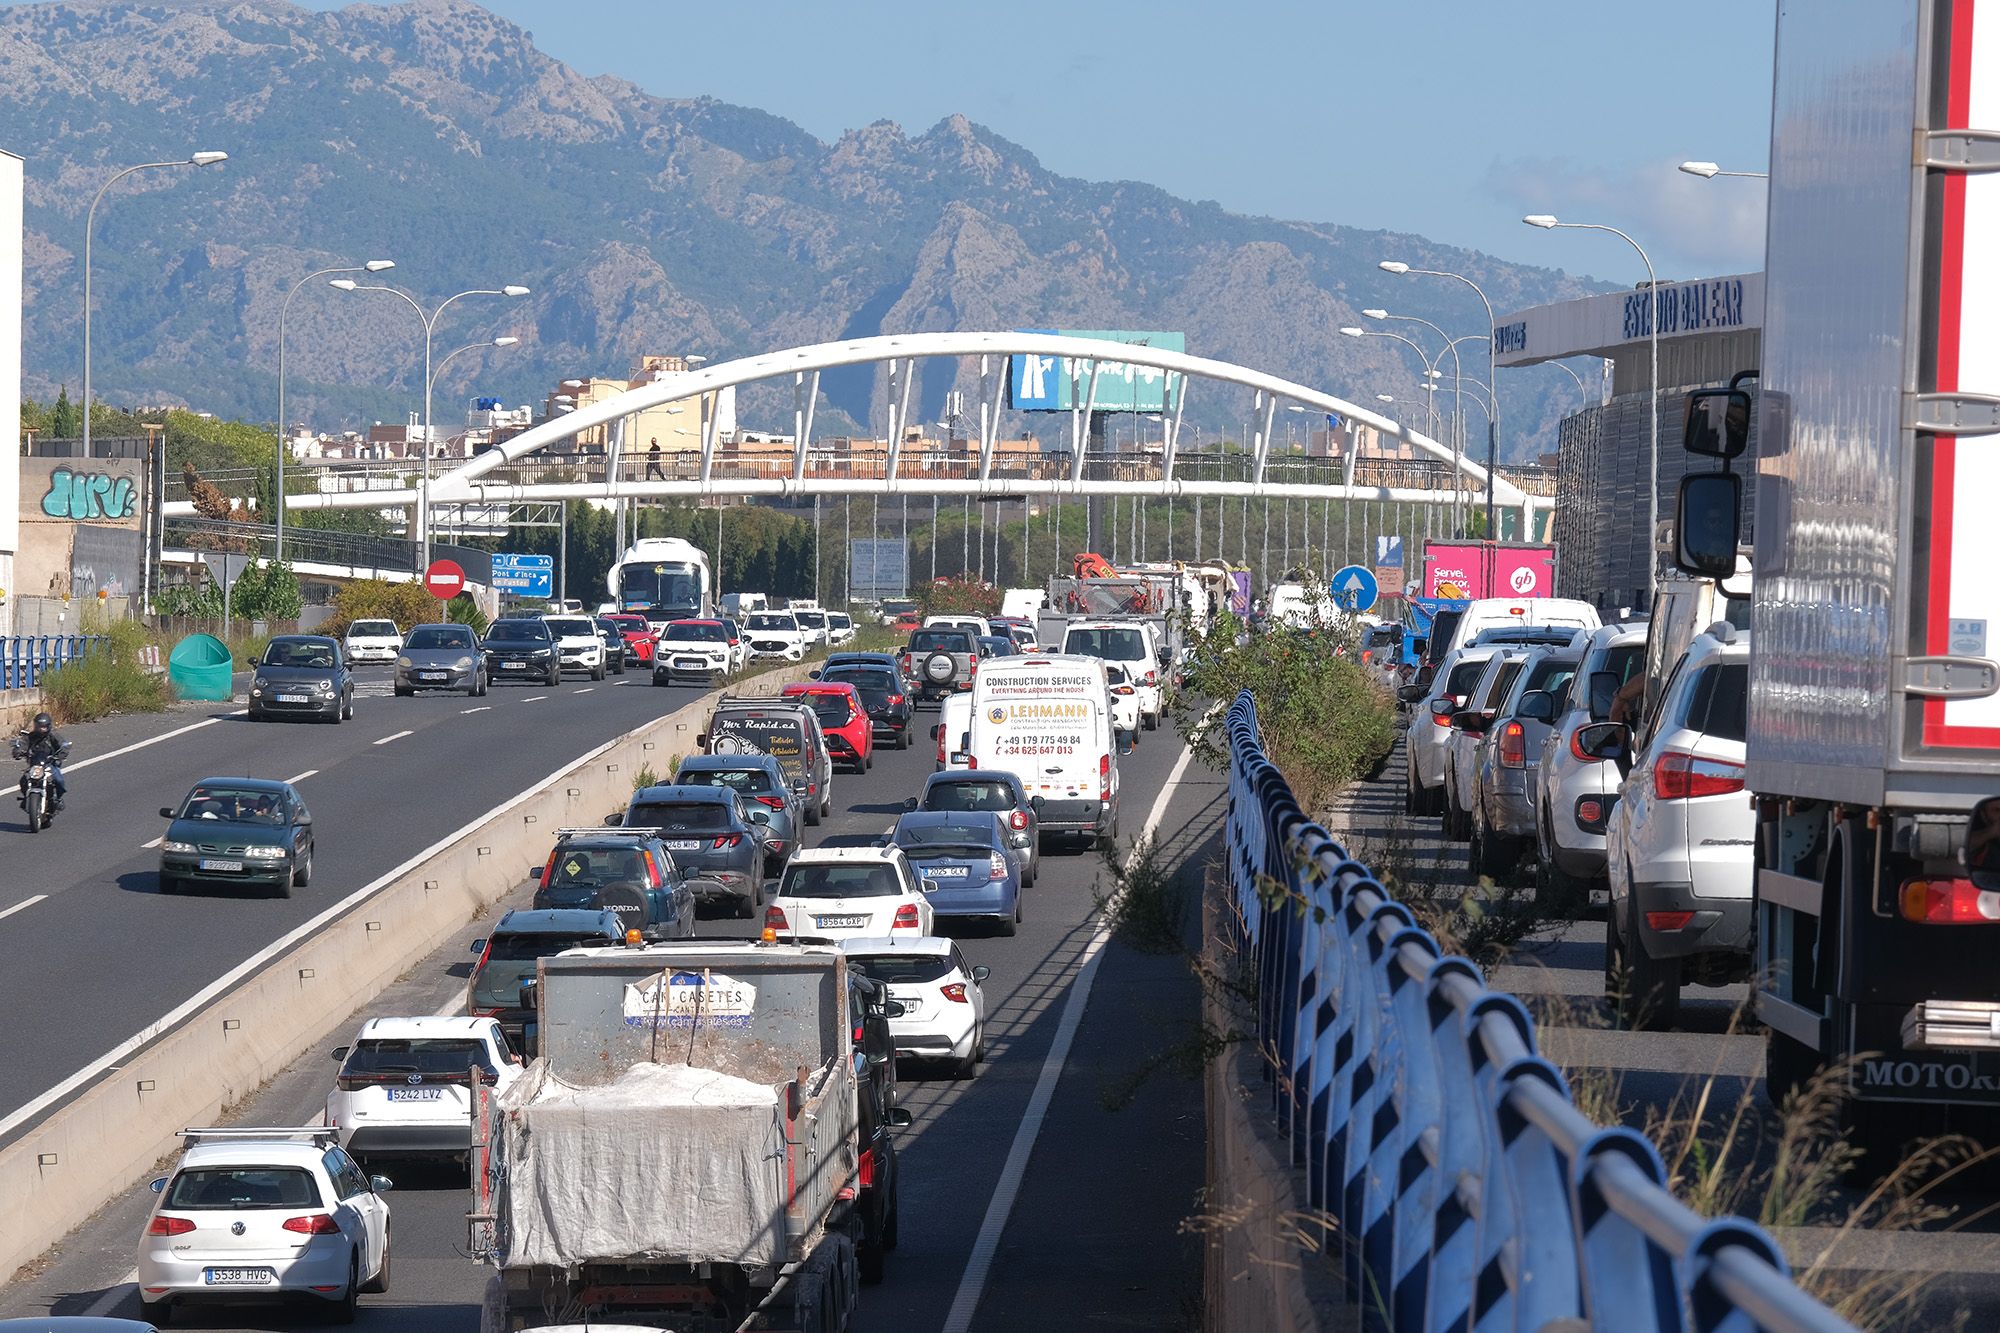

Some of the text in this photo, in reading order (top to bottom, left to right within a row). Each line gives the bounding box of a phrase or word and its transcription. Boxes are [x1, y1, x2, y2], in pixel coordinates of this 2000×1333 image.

[1623, 280, 1743, 339] ESTADIO BALEAR
[538, 558, 550, 566] 3A
[1514, 571, 1532, 590] gb
[986, 677, 1092, 686] CONSTRUCTION SERVICES
[1010, 704, 1088, 718] LEHMANN
[722, 719, 796, 730] Mr Rapid.es
[1004, 736, 1081, 745] +49 179 775 49 84
[1004, 746, 1073, 755] +34 625 647 013
[603, 904, 640, 912] HONDA
[823, 917, 862, 926] 9564 GXP
[394, 1090, 442, 1100] 5242 LVZ
[214, 1270, 267, 1280] 5538 HVG
